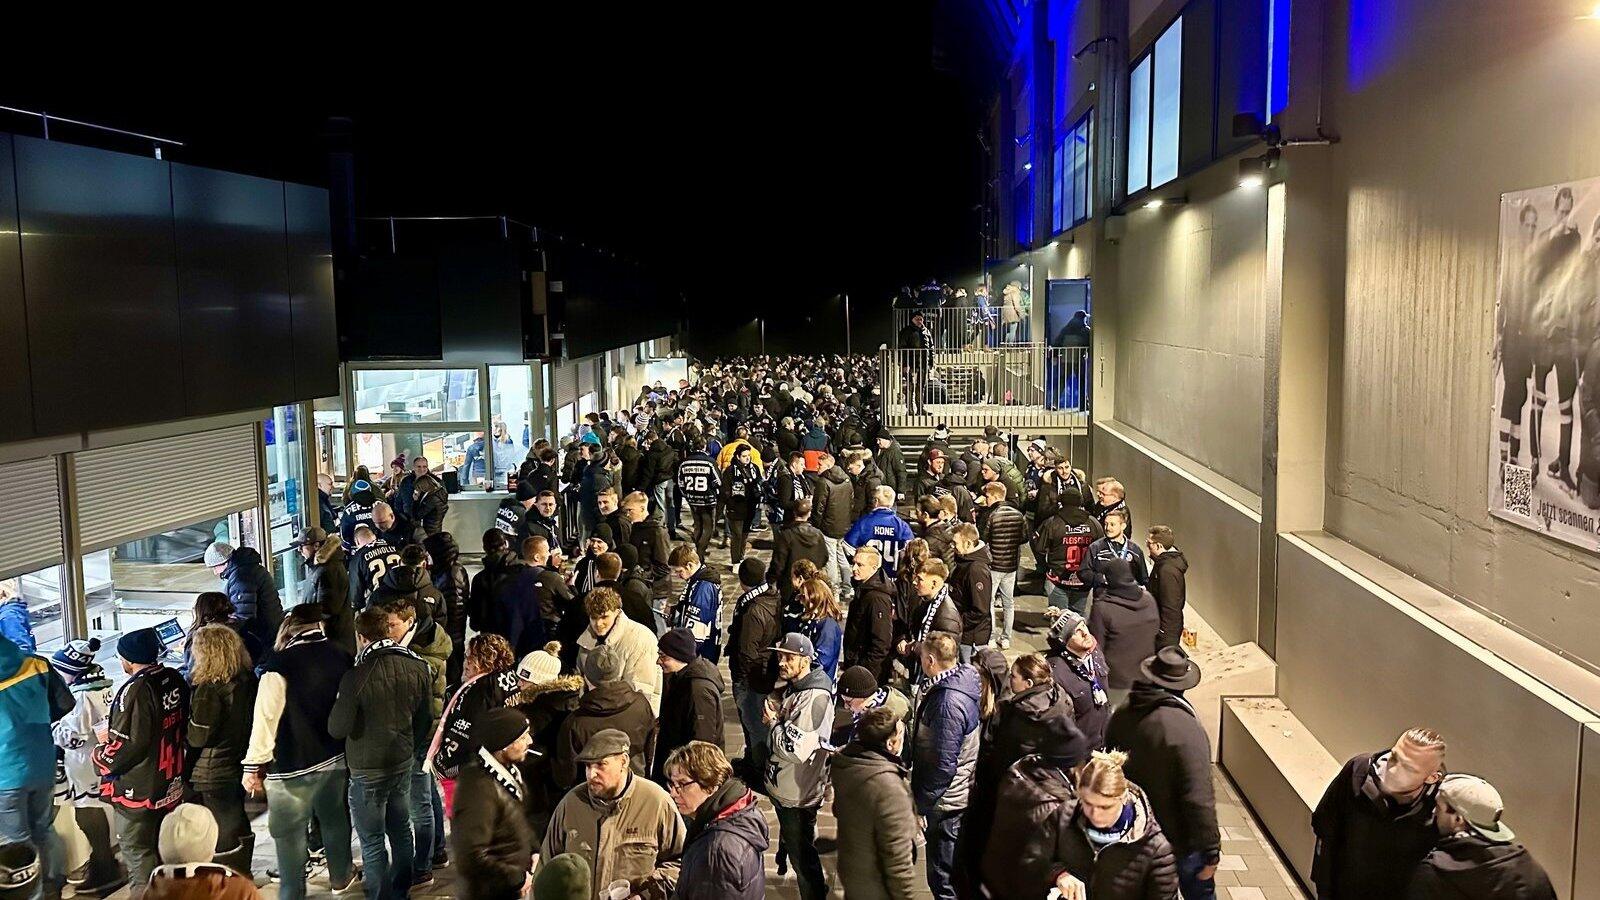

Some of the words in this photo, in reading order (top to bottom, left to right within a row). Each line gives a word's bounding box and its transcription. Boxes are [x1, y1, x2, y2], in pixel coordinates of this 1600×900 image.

[684, 475, 708, 492] 28
[1537, 500, 1557, 521] Jetzt
[1558, 508, 1594, 533] scannen
[874, 525, 895, 536] KONE
[364, 545, 397, 561] CONNOLLY
